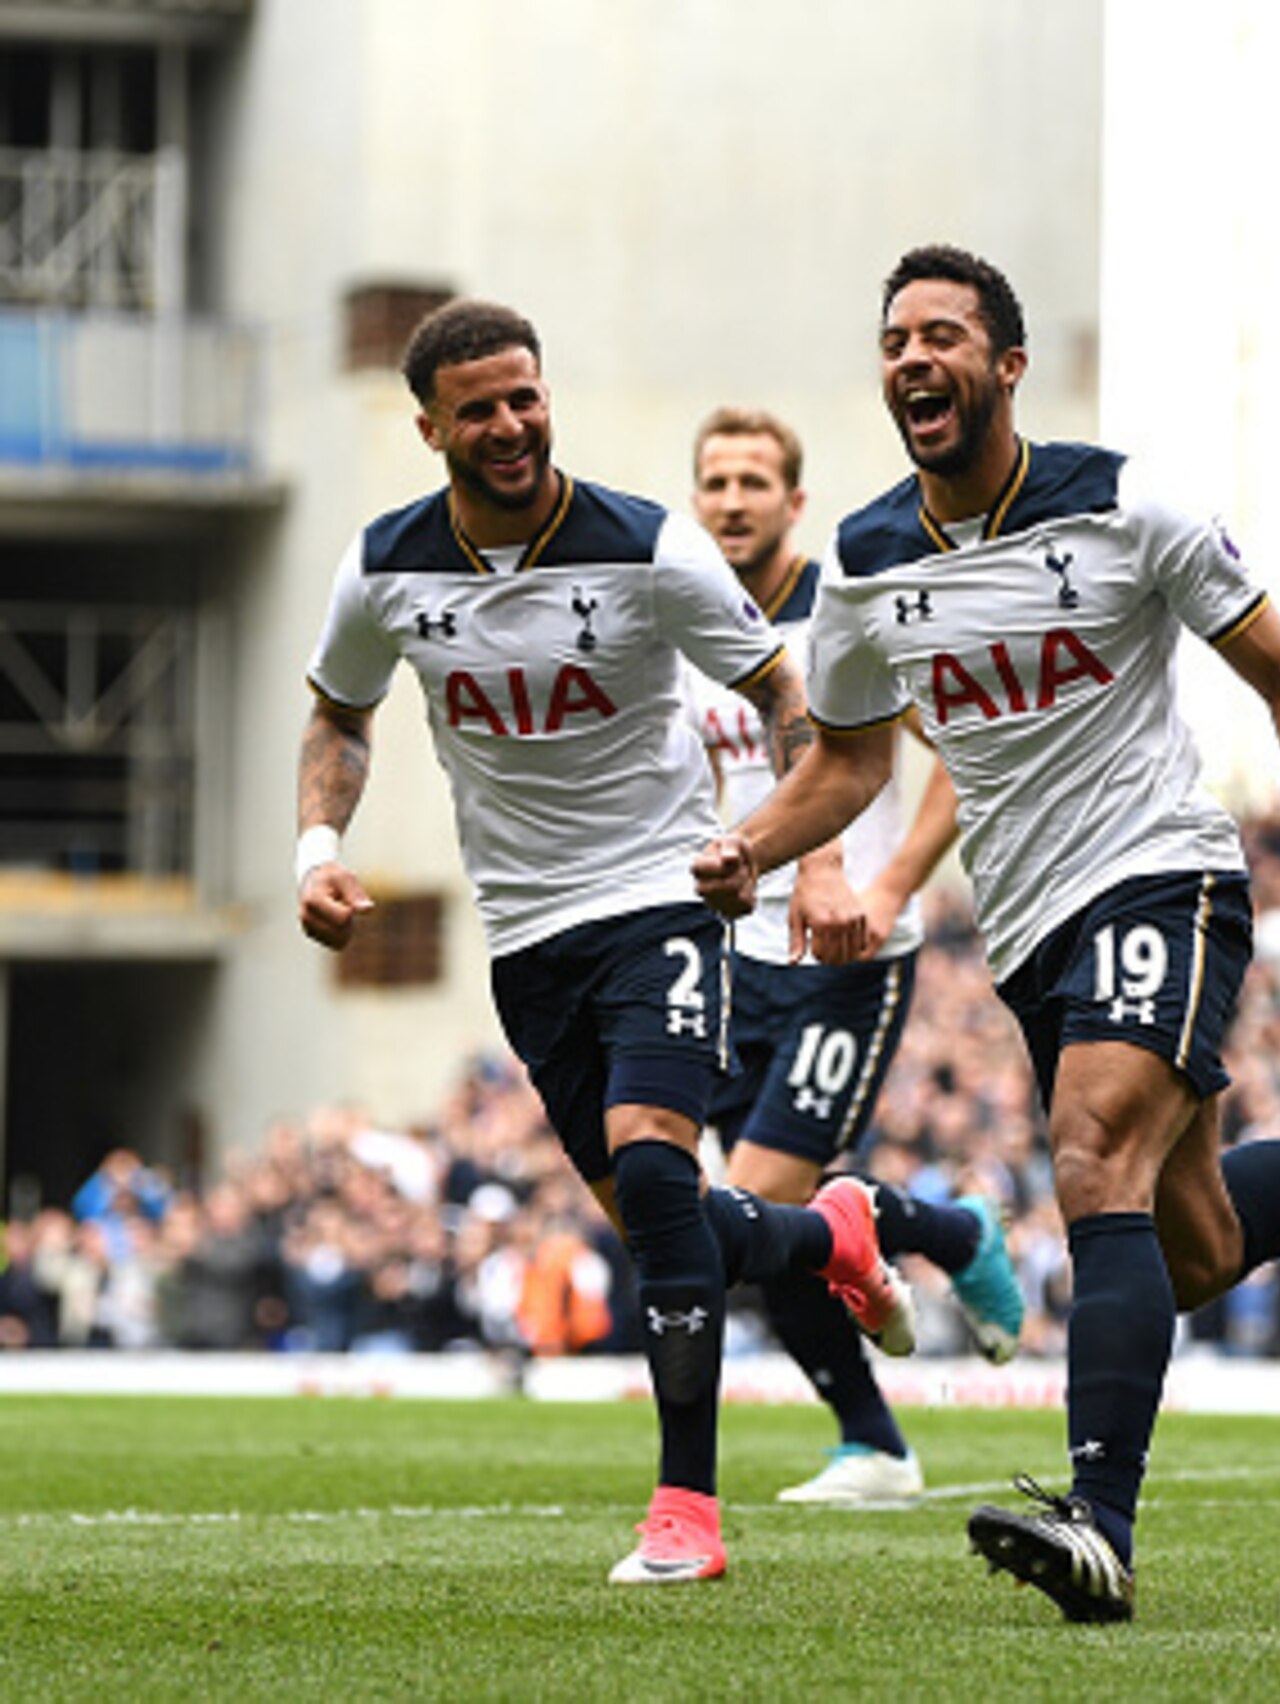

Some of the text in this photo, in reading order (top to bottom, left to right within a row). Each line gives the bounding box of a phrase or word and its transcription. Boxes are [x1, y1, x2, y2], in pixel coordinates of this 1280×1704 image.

[445, 663, 618, 736] AIA
[932, 628, 1115, 725] AIA
[703, 706, 770, 760] AI
[664, 937, 706, 1010] 2
[1093, 925, 1168, 1001] 19
[786, 1023, 857, 1095] 10
